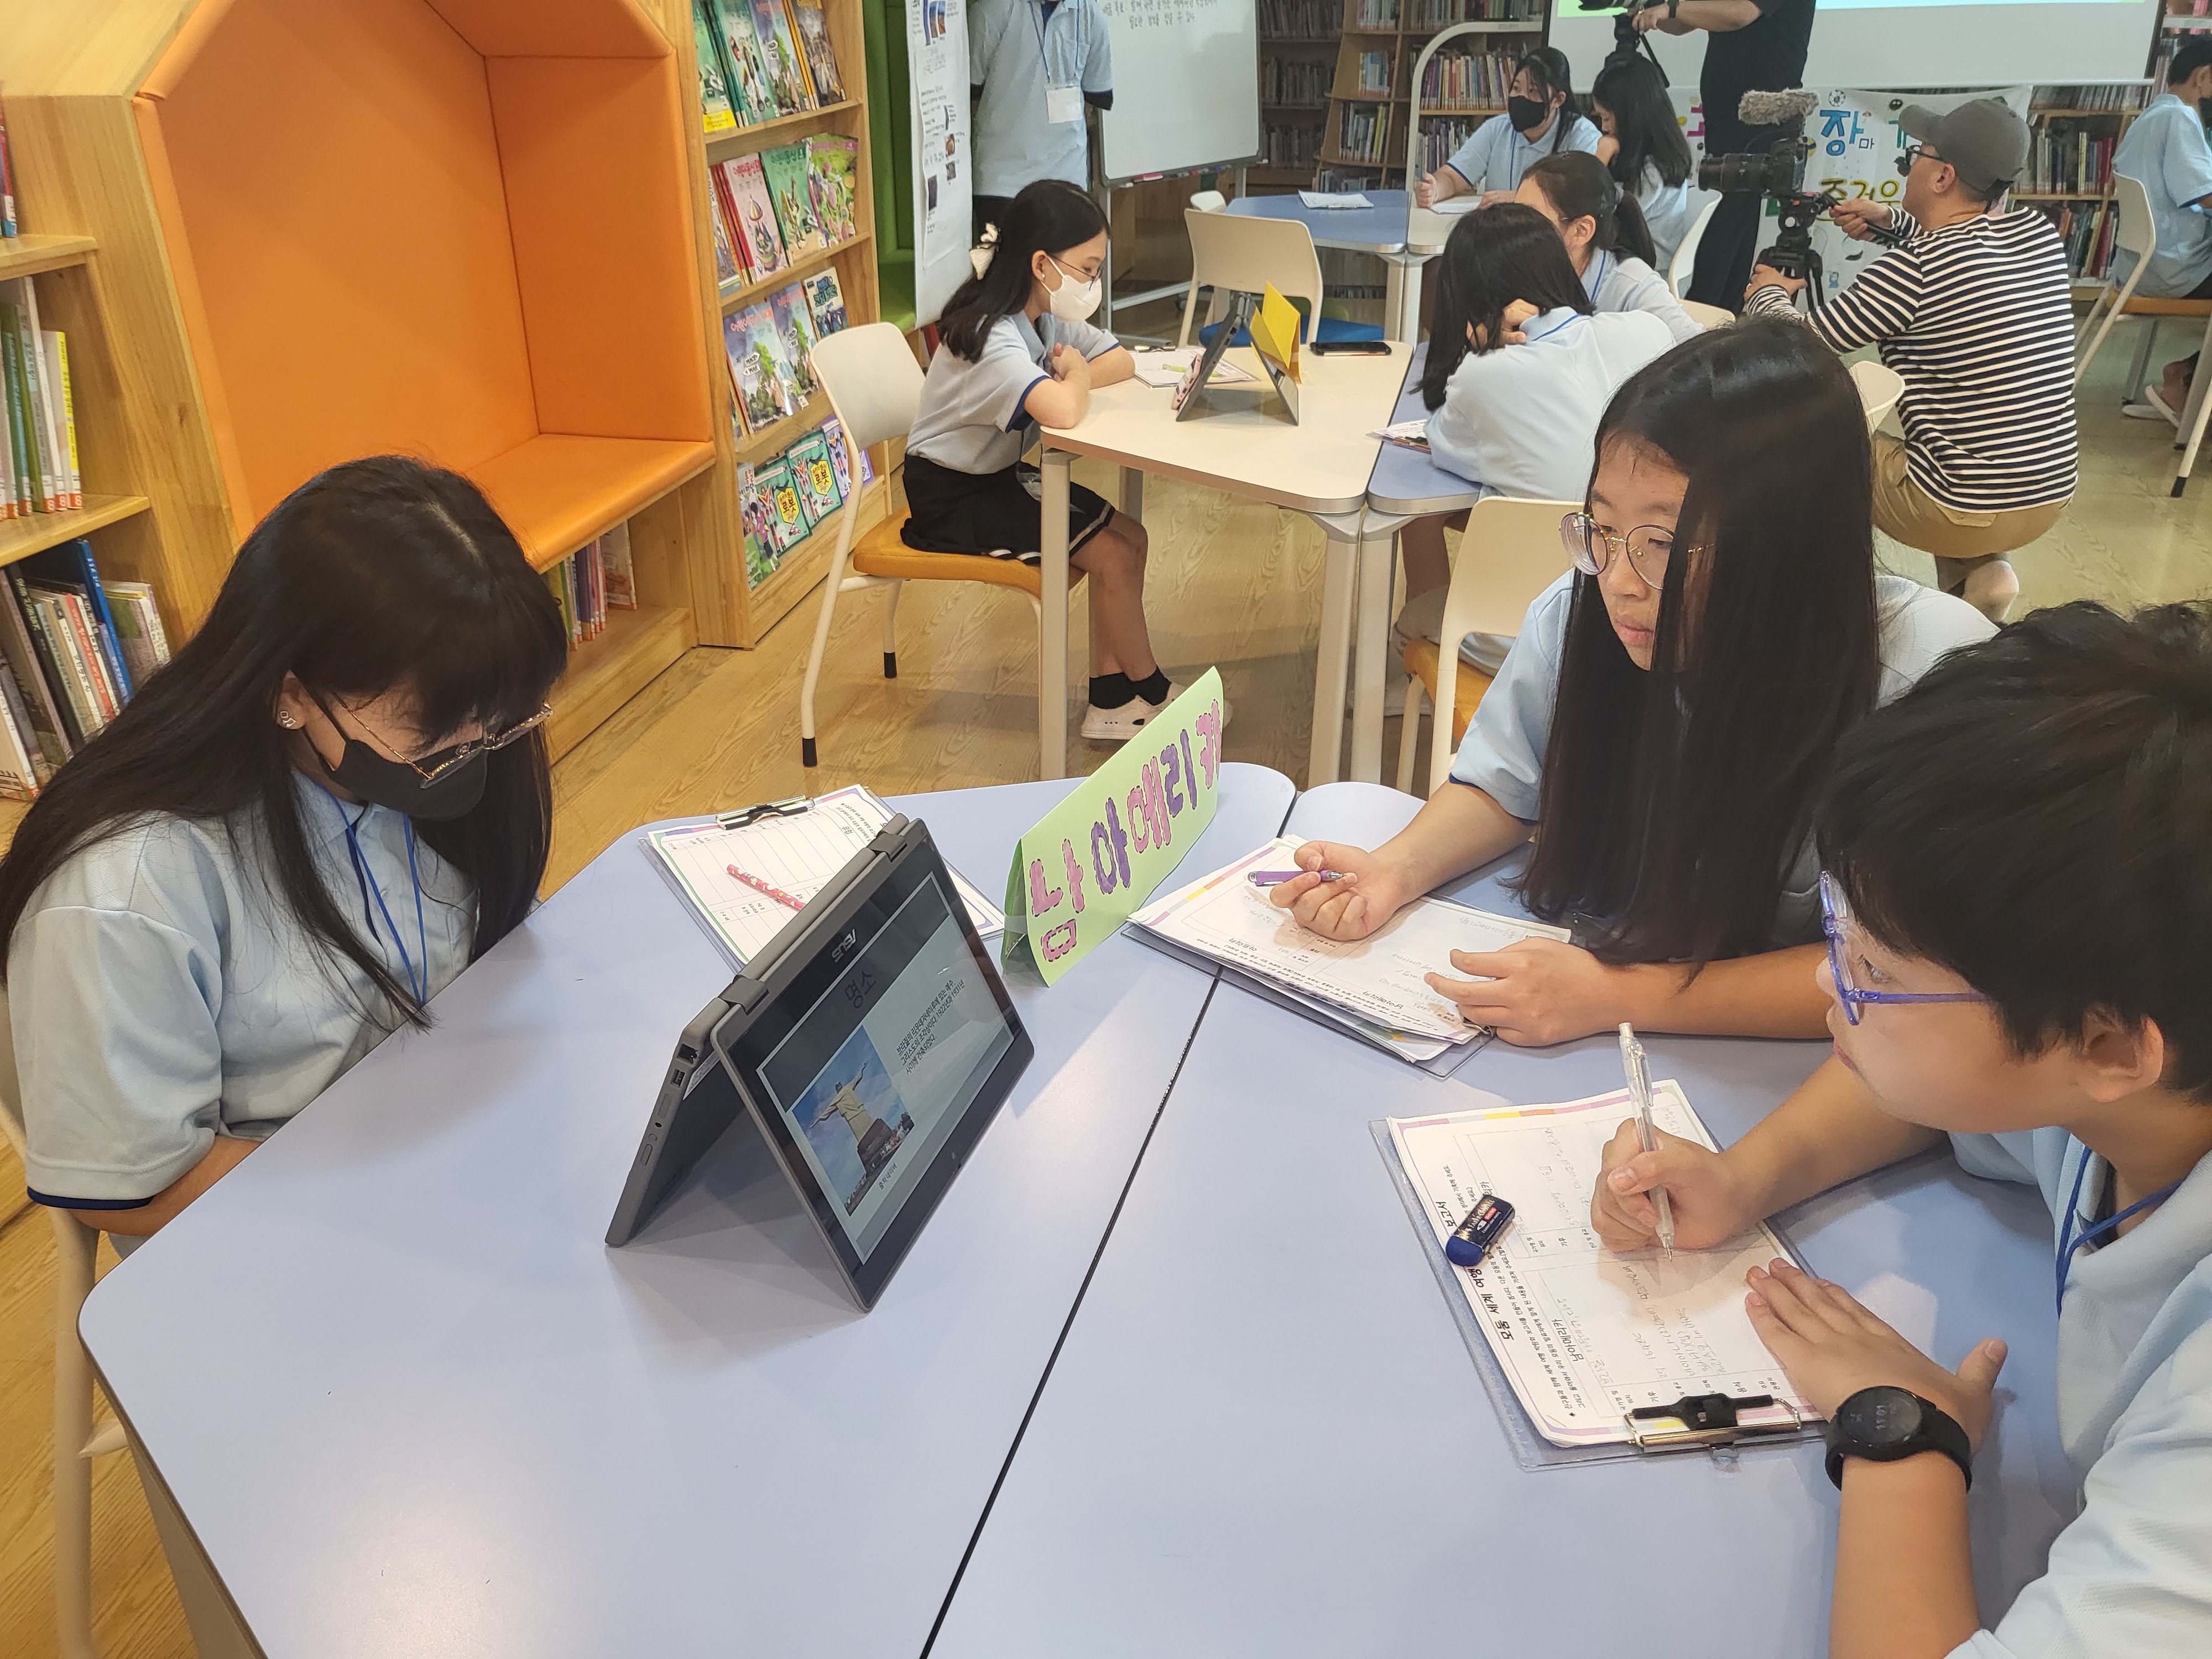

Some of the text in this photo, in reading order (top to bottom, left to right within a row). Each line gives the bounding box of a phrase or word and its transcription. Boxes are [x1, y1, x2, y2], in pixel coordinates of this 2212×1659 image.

[749, 365, 759, 373] WAR
[815, 469, 830, 486] 로봇
[781, 498, 796, 514] 로봇
[839, 826, 854, 834] 유럽
[832, 928, 858, 963] ASUS
[1225, 937, 1260, 951] 아프리카
[844, 969, 877, 1009] 명소
[1359, 990, 1405, 1009] 남아메리카
[895, 1030, 914, 1057] 브라질의
[937, 986, 947, 1001] 있는
[899, 1037, 921, 1067] 그리스도의
[951, 978, 965, 1000] 1931년
[904, 1030, 937, 1076] 사이에 건축되었다.
[1433, 1200, 1459, 1227] 보고서
[1557, 1236, 1569, 1246] 기후
[1467, 1267, 1516, 1341] 모둠 세계 여행
[1550, 1318, 1585, 1361] 남아메리카
[1646, 1390, 1661, 1402] 기후
[1731, 1381, 1747, 1394] 음식
